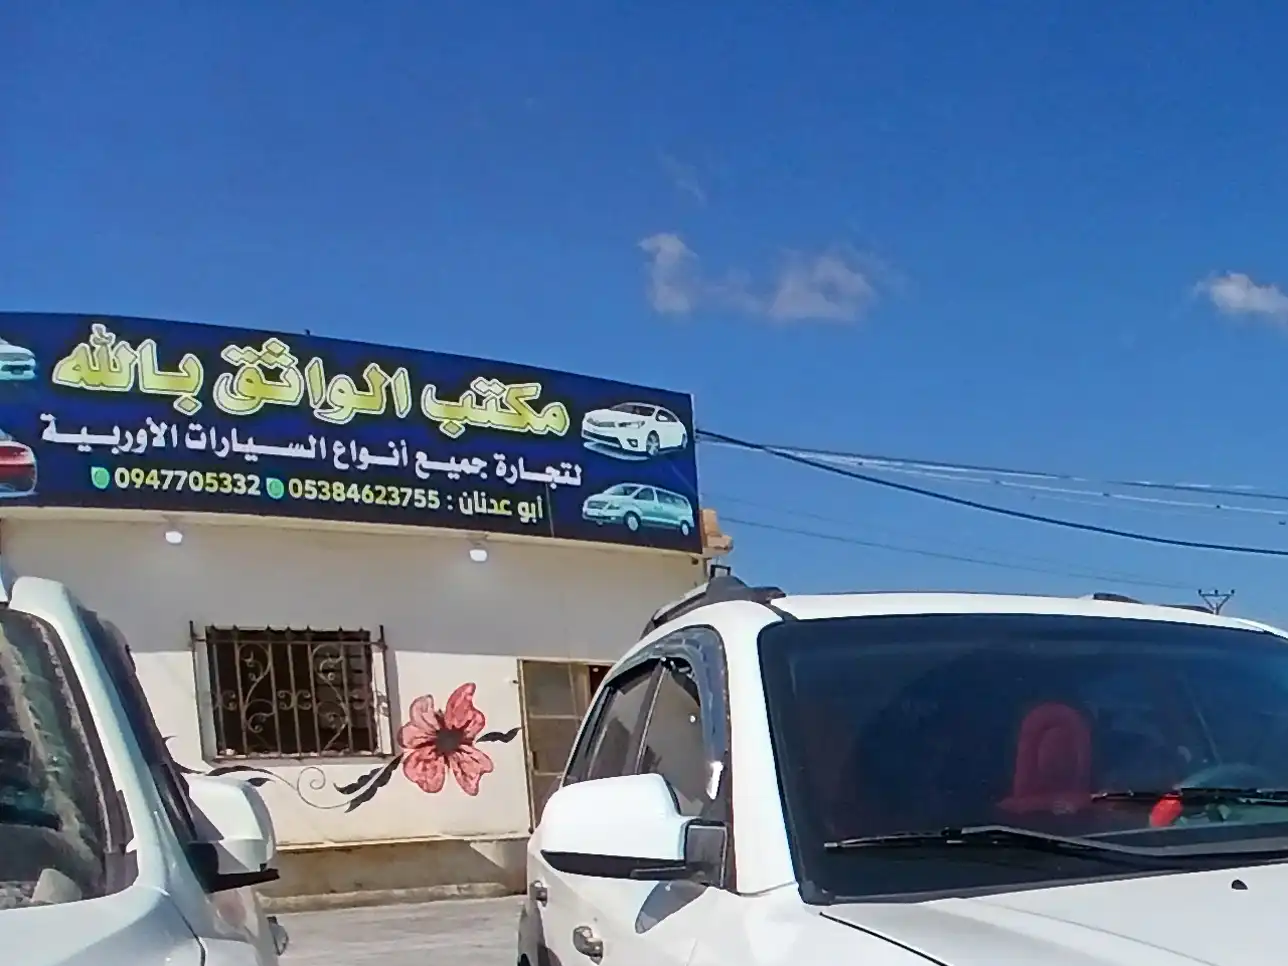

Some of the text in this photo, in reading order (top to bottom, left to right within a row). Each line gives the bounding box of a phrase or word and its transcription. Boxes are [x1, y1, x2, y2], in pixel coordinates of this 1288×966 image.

[52, 323, 570, 438] مكتب الواثق بالله
[185, 422, 326, 462] السيارات
[332, 439, 409, 470] أنواع
[414, 450, 488, 479] جميع
[493, 452, 582, 489] لتجارة
[114, 466, 261, 496] 0947705332
[288, 478, 441, 510] 05384623755
[458, 490, 512, 516] عدنان
